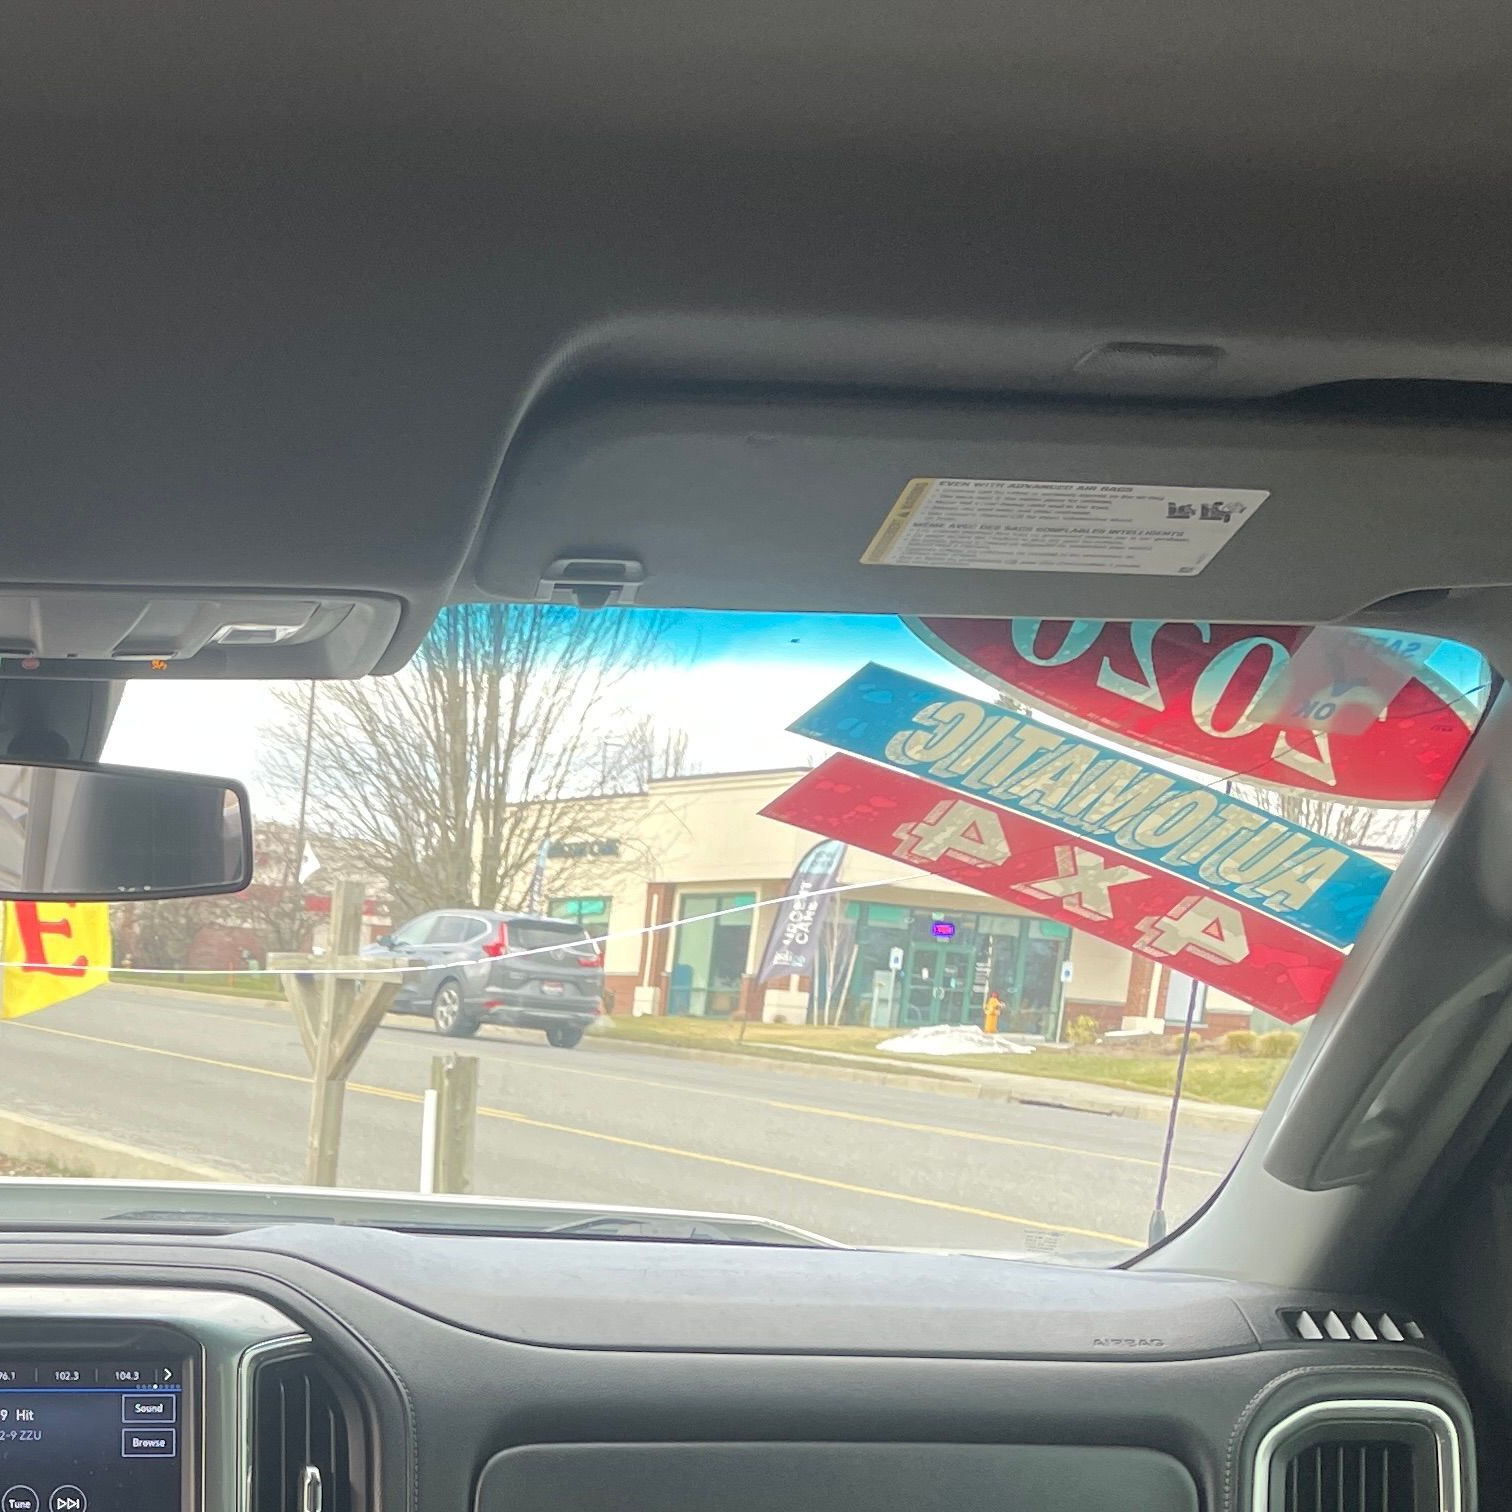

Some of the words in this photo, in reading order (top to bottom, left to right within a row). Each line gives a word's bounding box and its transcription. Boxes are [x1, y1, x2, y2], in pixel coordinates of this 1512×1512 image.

[1092, 1337, 1165, 1348] AIRBAG
[54, 1371, 80, 1381] 102.3
[115, 1371, 140, 1381] 104.3
[134, 1403, 163, 1414] Sound
[16, 1409, 34, 1421] Hit
[19, 1430, 42, 1441] ZZU
[132, 1437, 166, 1448] Browse
[9, 1499, 32, 1510] Tune
